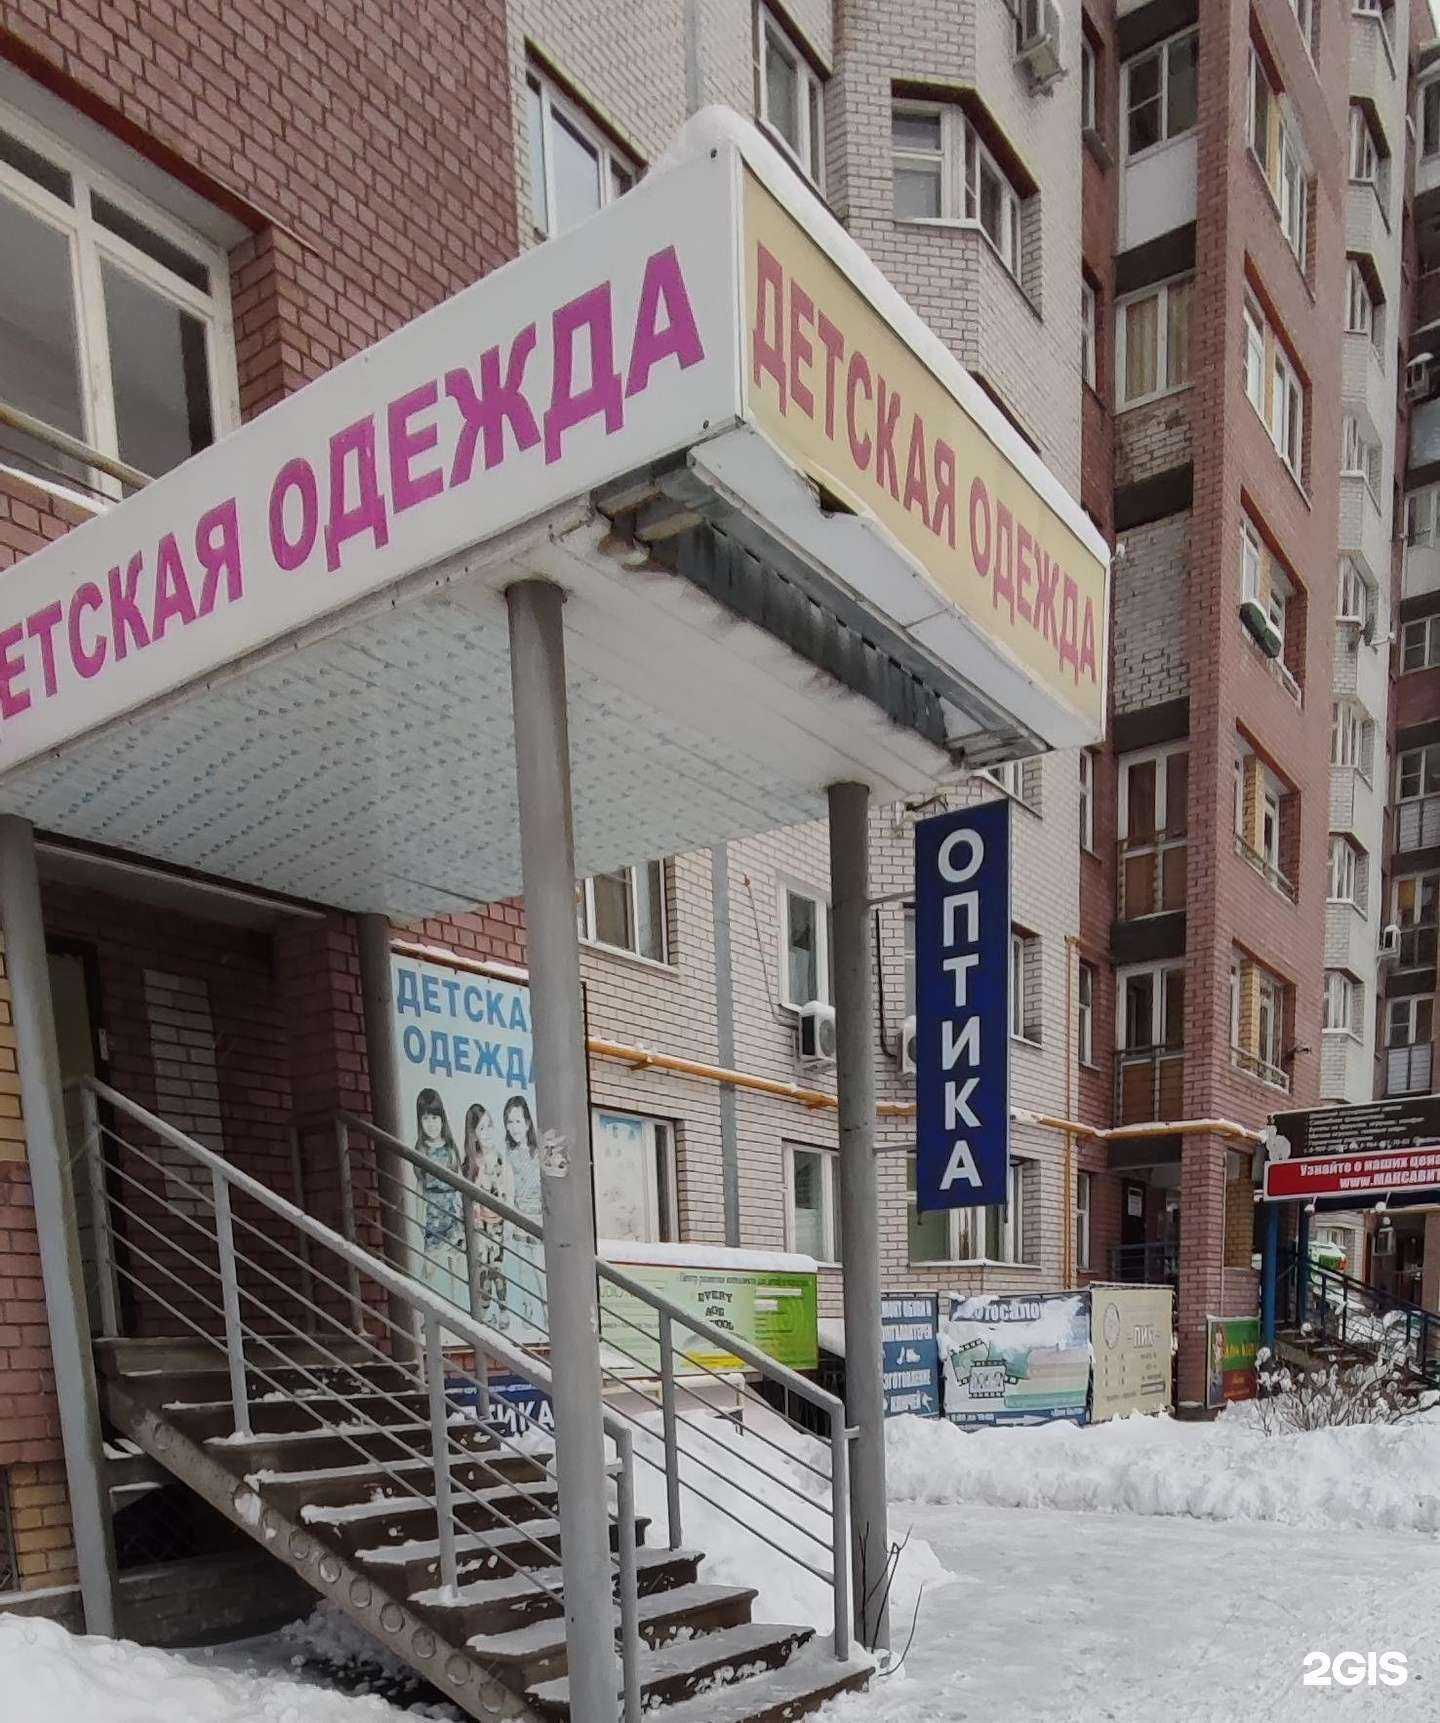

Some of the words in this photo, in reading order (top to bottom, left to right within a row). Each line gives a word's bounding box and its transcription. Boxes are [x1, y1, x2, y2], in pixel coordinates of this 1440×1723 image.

[0, 497, 244, 720] ЕТСКАЯ
[268, 244, 705, 573] ОДЕЖДА
[753, 241, 956, 550] ДЕТСКАЯ
[968, 476, 1097, 686] ОДЕЖДА
[396, 968, 528, 1033] ДЕТСКА
[938, 828, 985, 1191] ОПТИКА
[403, 1025, 534, 1090] ОДЕЖД
[1301, 1161, 1352, 1176] Узнайте
[698, 1290, 733, 1303] EVERY
